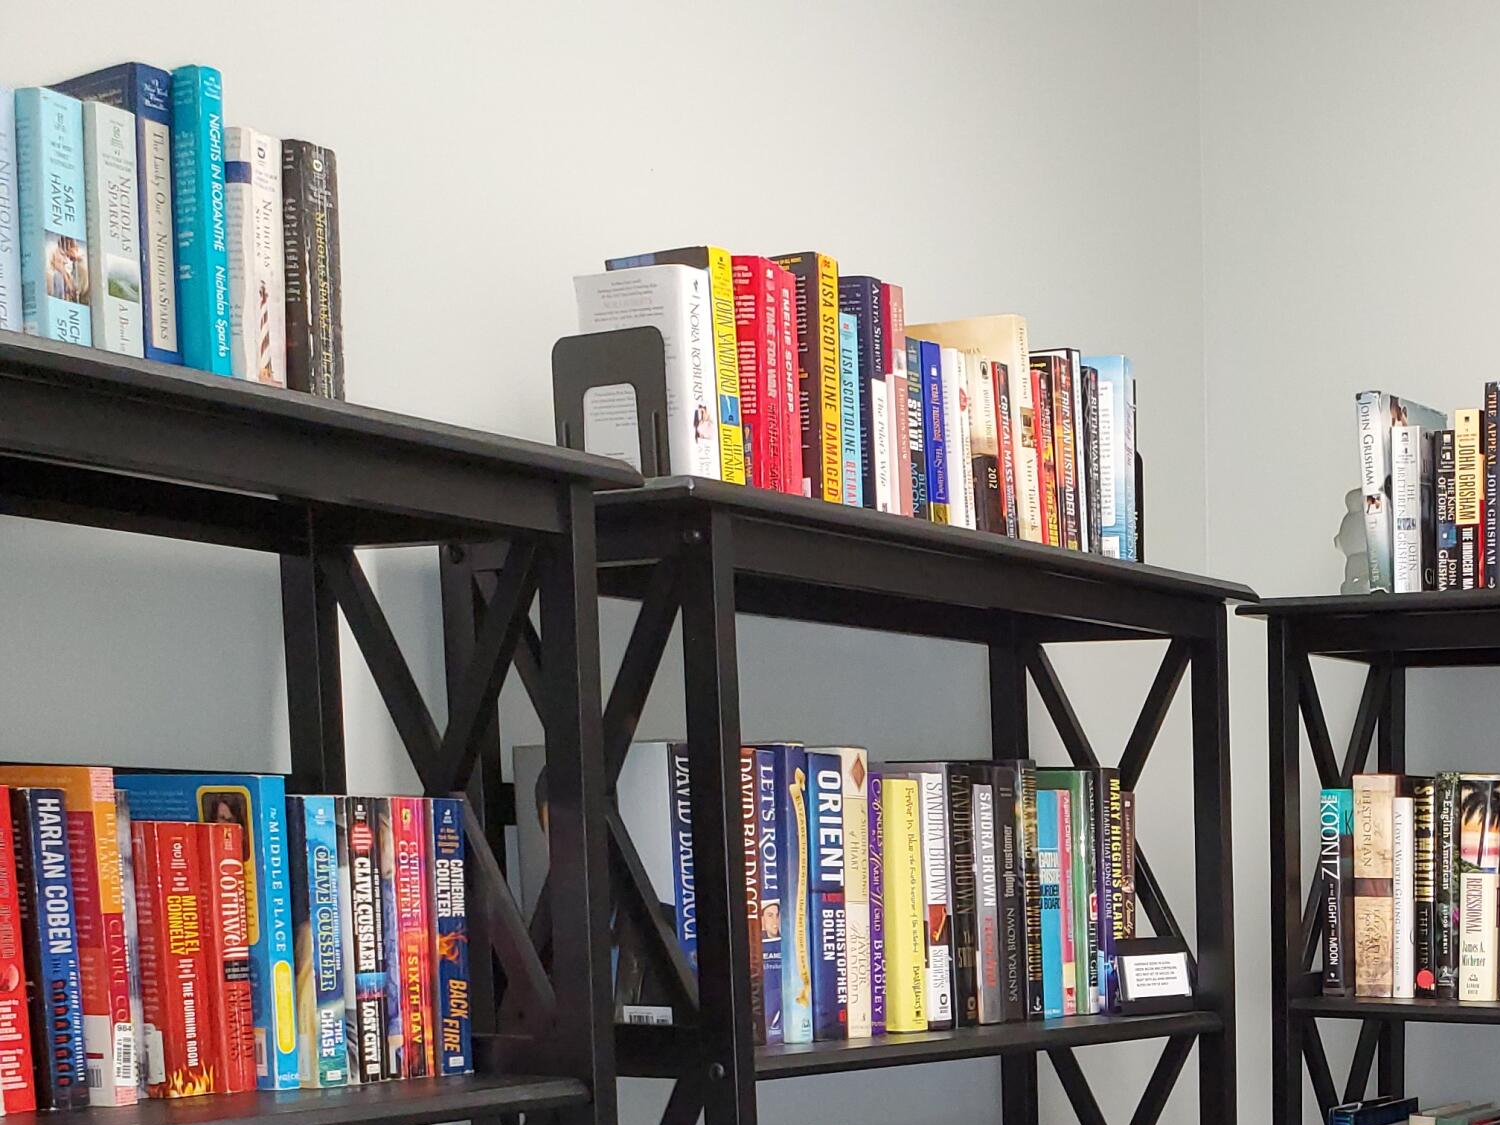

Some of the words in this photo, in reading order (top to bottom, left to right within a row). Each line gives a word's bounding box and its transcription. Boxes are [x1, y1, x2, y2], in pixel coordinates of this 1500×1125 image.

[152, 131, 163, 152] The
[209, 113, 221, 162] NIGHTS
[211, 164, 222, 178] IN
[50, 173, 63, 227] HAVEN
[63, 184, 76, 224] SAFE
[108, 181, 119, 240] SPARKS
[119, 176, 132, 252] NICHOLAS
[155, 192, 165, 216] One
[212, 181, 225, 252] RODANTHE
[155, 232, 168, 290] NICHOLAS
[159, 292, 169, 341] SPARKS
[216, 265, 226, 316] Nicholas
[714, 297, 733, 330] JOHN
[821, 273, 834, 308] LISA
[871, 283, 881, 324] ANITA
[216, 319, 227, 358] Sparks
[691, 302, 701, 346] NORA
[873, 327, 882, 373] SHREVE
[693, 349, 704, 405] ROBERTS
[717, 332, 738, 394] SANDFORD
[823, 314, 837, 412] SCOTTOLINE
[841, 348, 852, 378] LISA
[842, 380, 856, 455] SCOTTOLINE
[1000, 395, 1011, 447] CRITICAL
[1358, 400, 1370, 431] JOHN
[1488, 391, 1497, 417] THE
[825, 422, 839, 497] DAMAGED
[1005, 451, 1014, 487] MASS
[1361, 434, 1376, 485] GRISHAM
[1488, 420, 1497, 469] APPEAL
[987, 467, 998, 489] 2012
[1488, 473, 1497, 505] JOHN
[1487, 506, 1497, 565] GRISHAM
[760, 764, 777, 827] LET'S
[979, 792, 992, 850] SANDRA
[1109, 778, 1120, 819] MARY
[37, 798, 65, 880] HARLAN
[817, 769, 845, 886] ORIENT
[1320, 799, 1340, 880] KOONTZ
[269, 822, 283, 890] MIDDLE
[761, 831, 779, 890] ROLL!
[983, 855, 996, 907] BROWN
[1110, 826, 1122, 887] HIGGINS
[436, 858, 451, 918] COULTER
[450, 858, 465, 917] CATHERINE
[1465, 877, 1483, 934] RECESSIONAL
[44, 885, 73, 955] COBEN
[166, 895, 185, 957] CONNELLY
[182, 895, 200, 959] MICHAEL
[274, 898, 287, 953] PLACE
[822, 909, 836, 961] BOLLEN
[1112, 891, 1123, 940] CLARK
[835, 909, 847, 1005] CHRISTOPHER
[448, 979, 468, 1020] BACK
[321, 1008, 335, 1057] CHASE
[442, 1018, 461, 1052] FIRE
